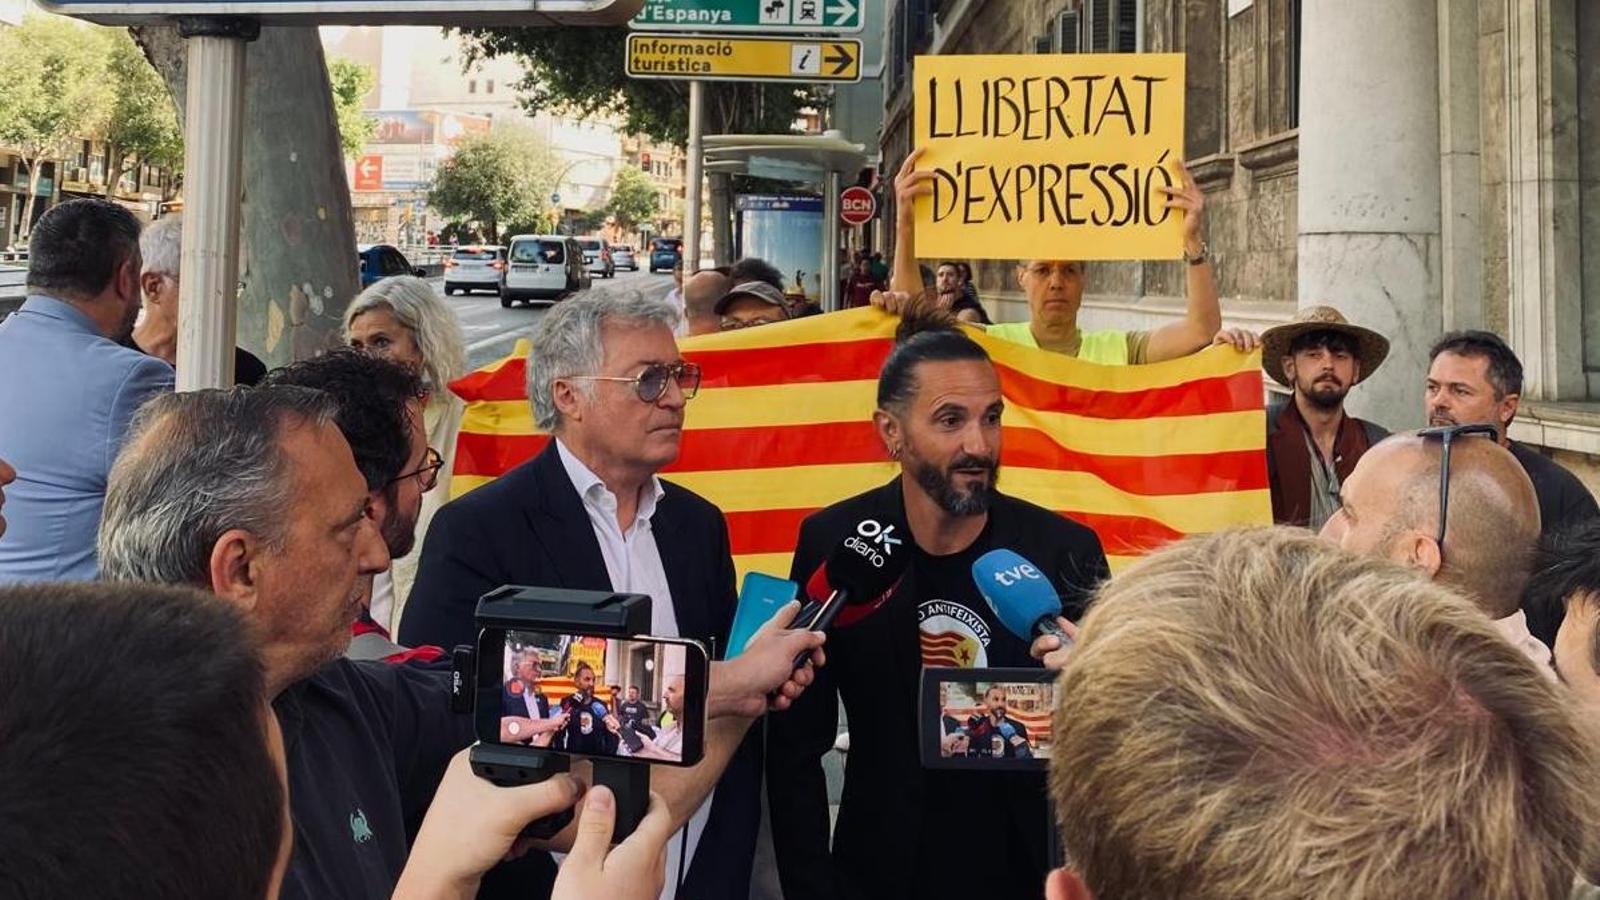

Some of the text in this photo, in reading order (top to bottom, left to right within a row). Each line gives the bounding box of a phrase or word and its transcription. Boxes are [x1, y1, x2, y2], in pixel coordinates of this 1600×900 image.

[633, 39, 733, 56] informació
[928, 74, 1168, 141] LLIBERTAT
[842, 198, 871, 211] BCN
[931, 148, 1174, 227] D'EXPRESSIÓ
[843, 536, 885, 568] diario
[857, 519, 903, 555] OK
[994, 564, 1041, 587] tve
[927, 603, 992, 648] ANTIFEIXISTA
